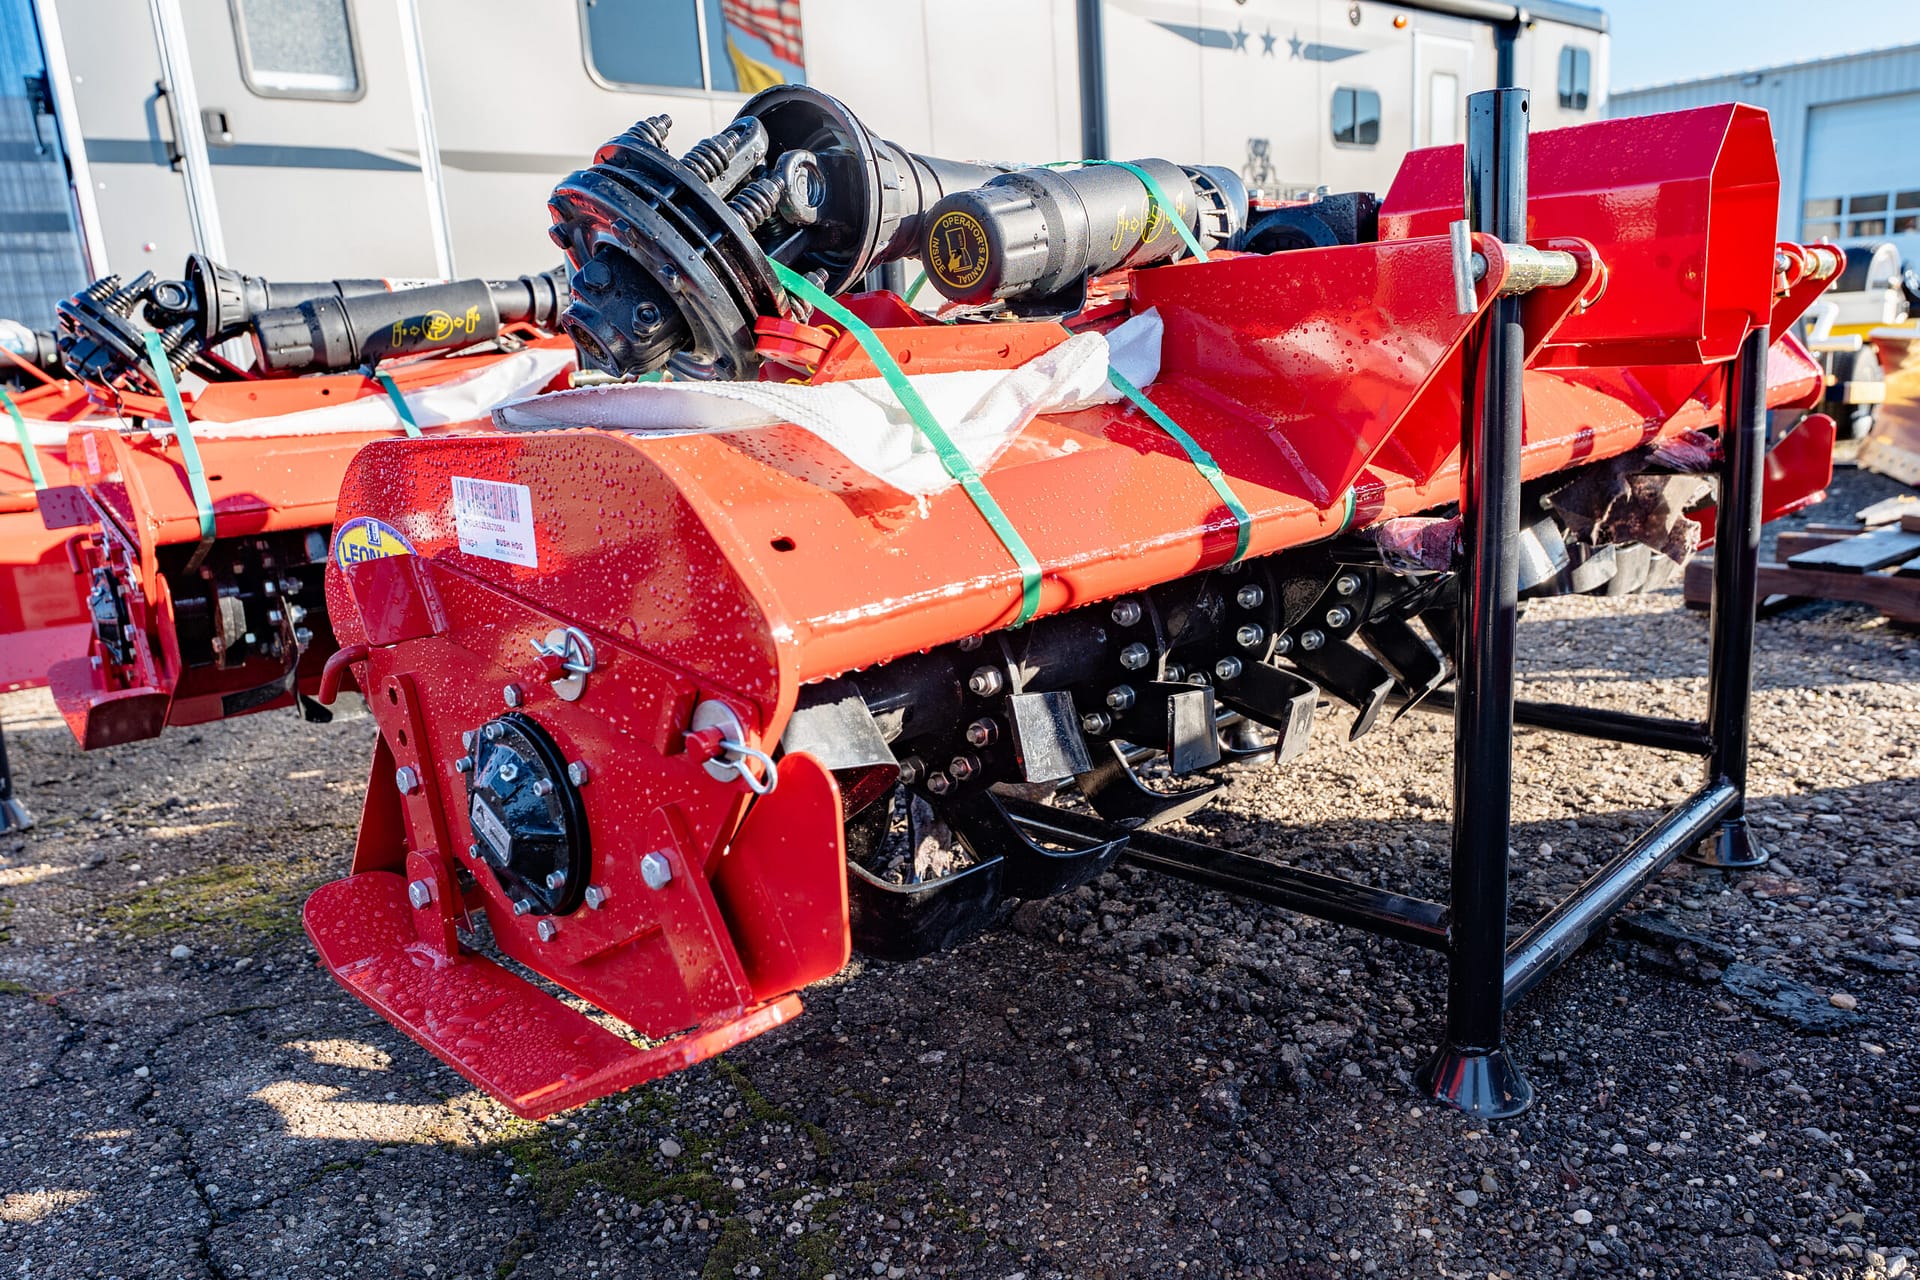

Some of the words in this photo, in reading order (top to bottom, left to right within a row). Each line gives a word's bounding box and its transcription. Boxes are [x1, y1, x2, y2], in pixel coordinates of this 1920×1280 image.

[942, 216, 986, 254] OPERATOR'S
[932, 237, 946, 273] INSIDE
[957, 255, 985, 284] MANUAL
[341, 541, 396, 563] LEON
